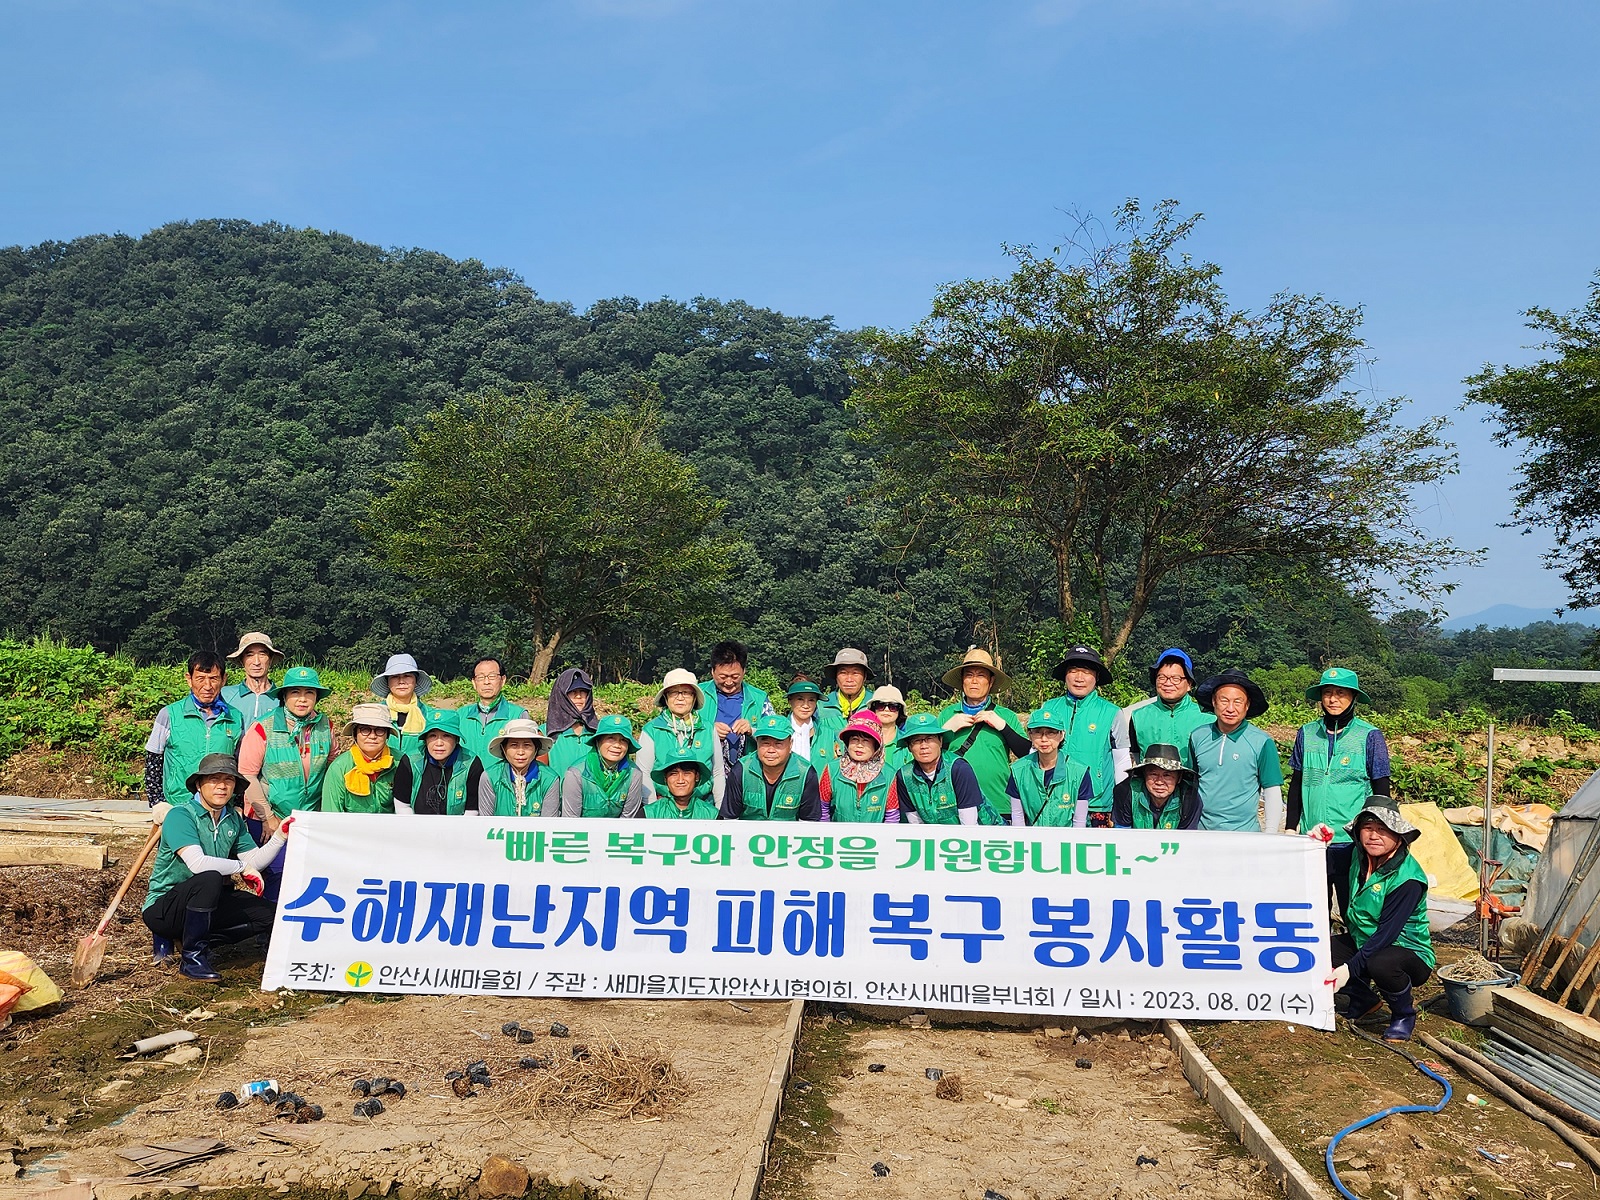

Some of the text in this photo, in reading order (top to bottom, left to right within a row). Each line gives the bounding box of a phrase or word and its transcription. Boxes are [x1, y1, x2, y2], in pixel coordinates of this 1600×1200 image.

[606, 832, 735, 867] 복구와
[748, 834, 878, 871] 안정을
[281, 876, 1320, 974] 수해재난지역 피해 복구 봉사활동
[287, 962, 336, 984] 주최:
[378, 965, 523, 991] 안산시새마을회
[544, 972, 587, 993] 주관
[865, 981, 1055, 1007] 안산시새마을부녀회
[1079, 987, 1122, 1010] 일시
[1142, 990, 1200, 1011] 2023.
[1208, 992, 1239, 1012] 08.
[1247, 993, 1272, 1012] 02
[1280, 993, 1314, 1016] (수)
